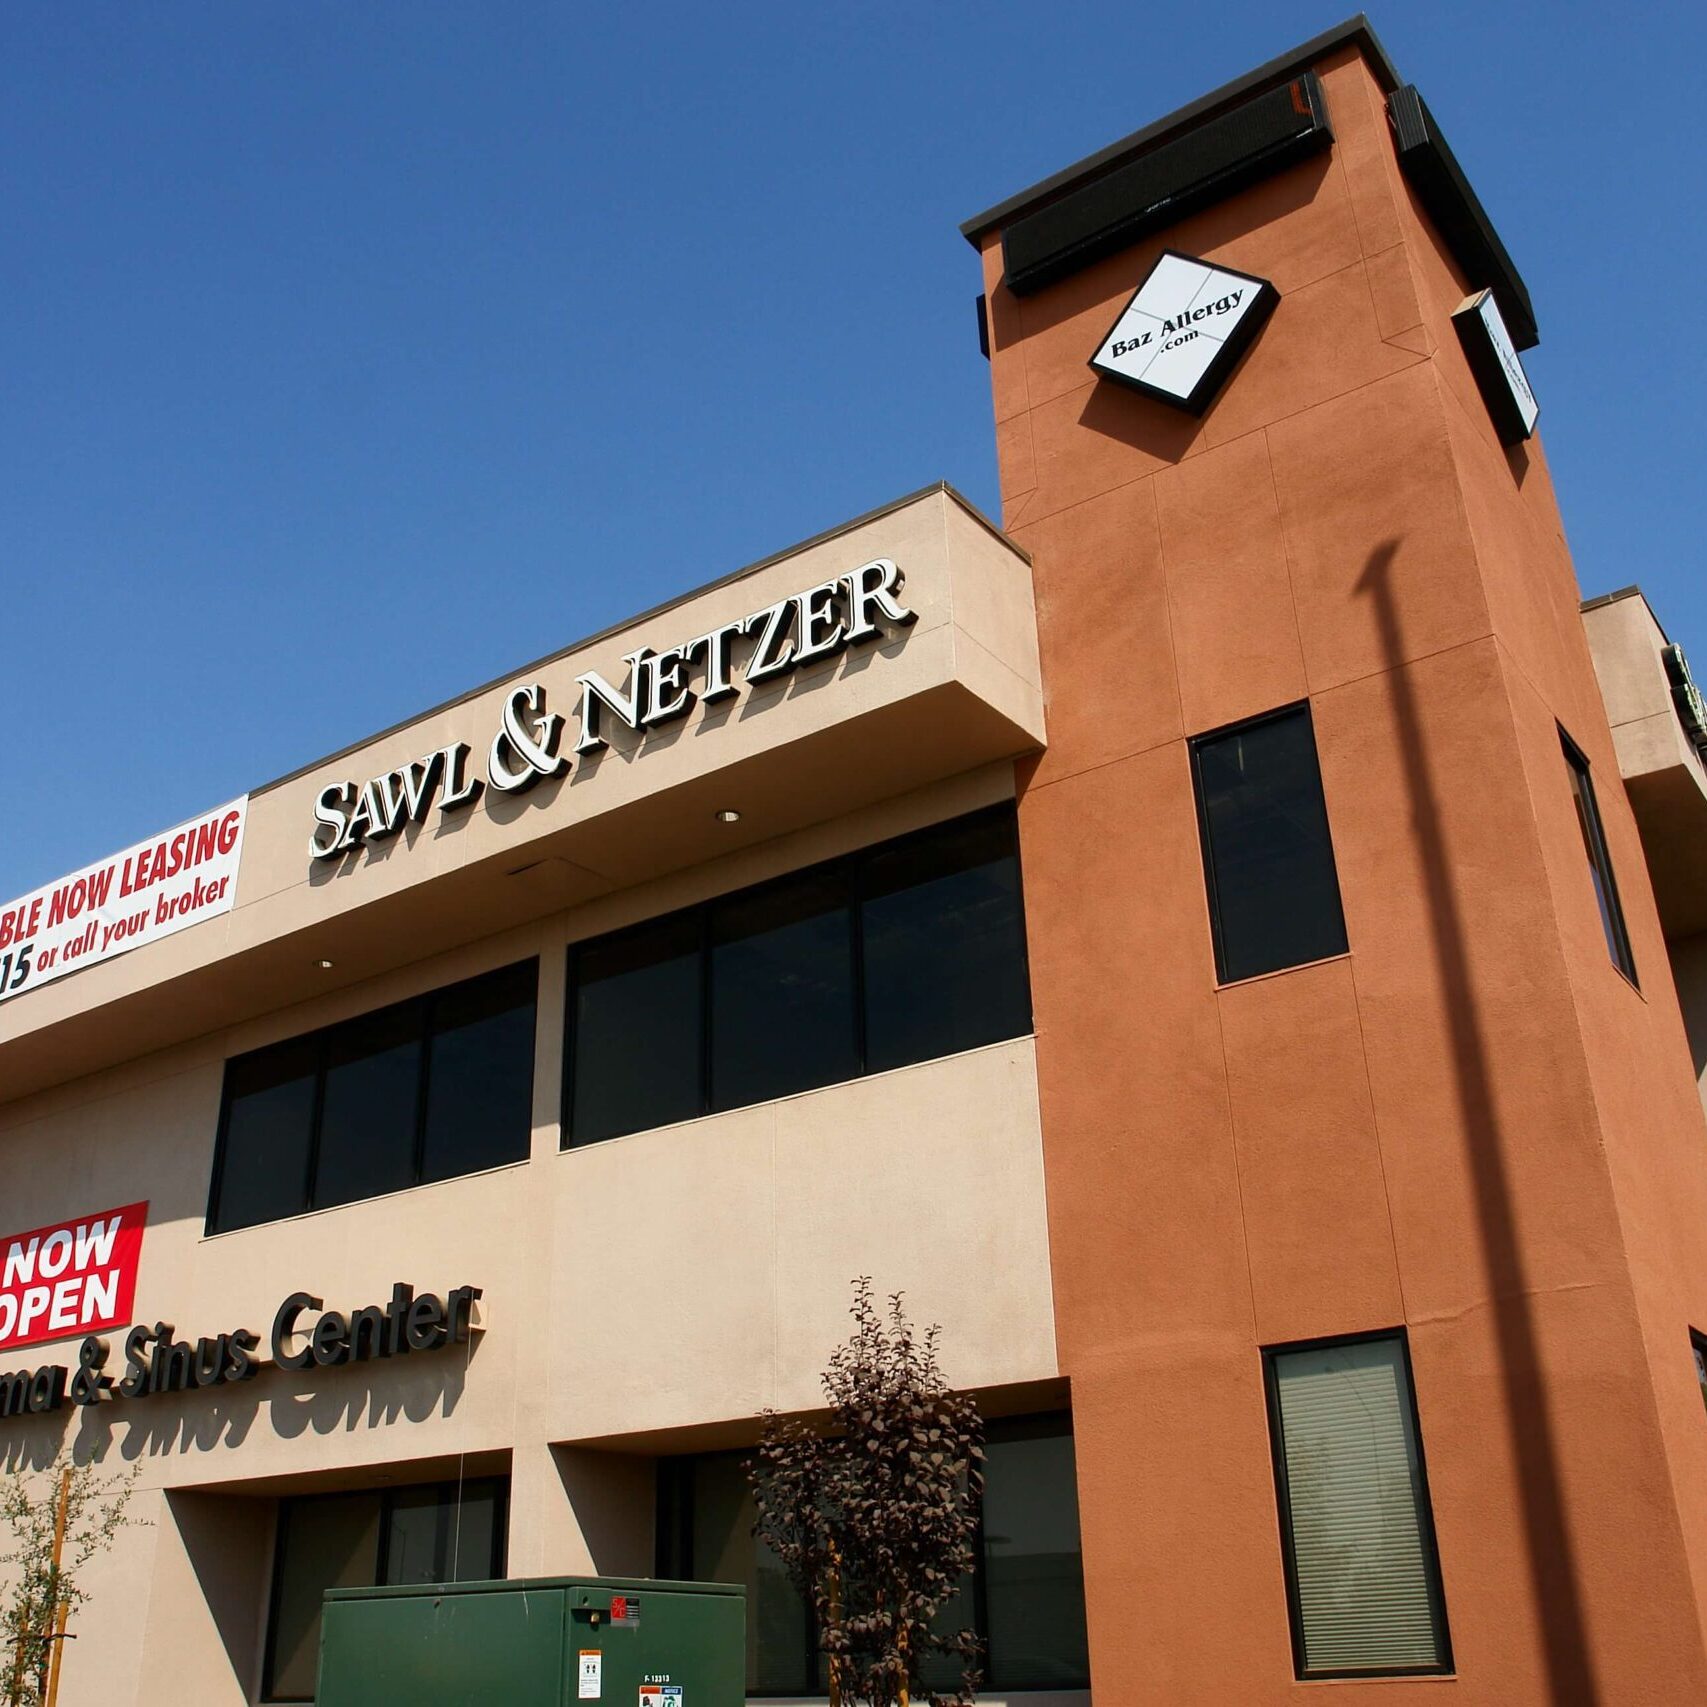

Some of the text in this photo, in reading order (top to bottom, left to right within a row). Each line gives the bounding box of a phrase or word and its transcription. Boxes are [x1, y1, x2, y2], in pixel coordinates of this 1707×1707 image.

[1111, 289, 1244, 358] Baz Allergy
[1160, 330, 1199, 353] .com
[308, 556, 919, 862] SAWL & NETZER
[47, 865, 115, 929] NOW
[119, 810, 240, 898] LEASING
[0, 874, 230, 994] 15 or call your broker
[2, 1215, 122, 1289] NOW
[71, 1335, 114, 1406] &
[119, 1321, 261, 1398] Sinus
[271, 1281, 483, 1371] Center
